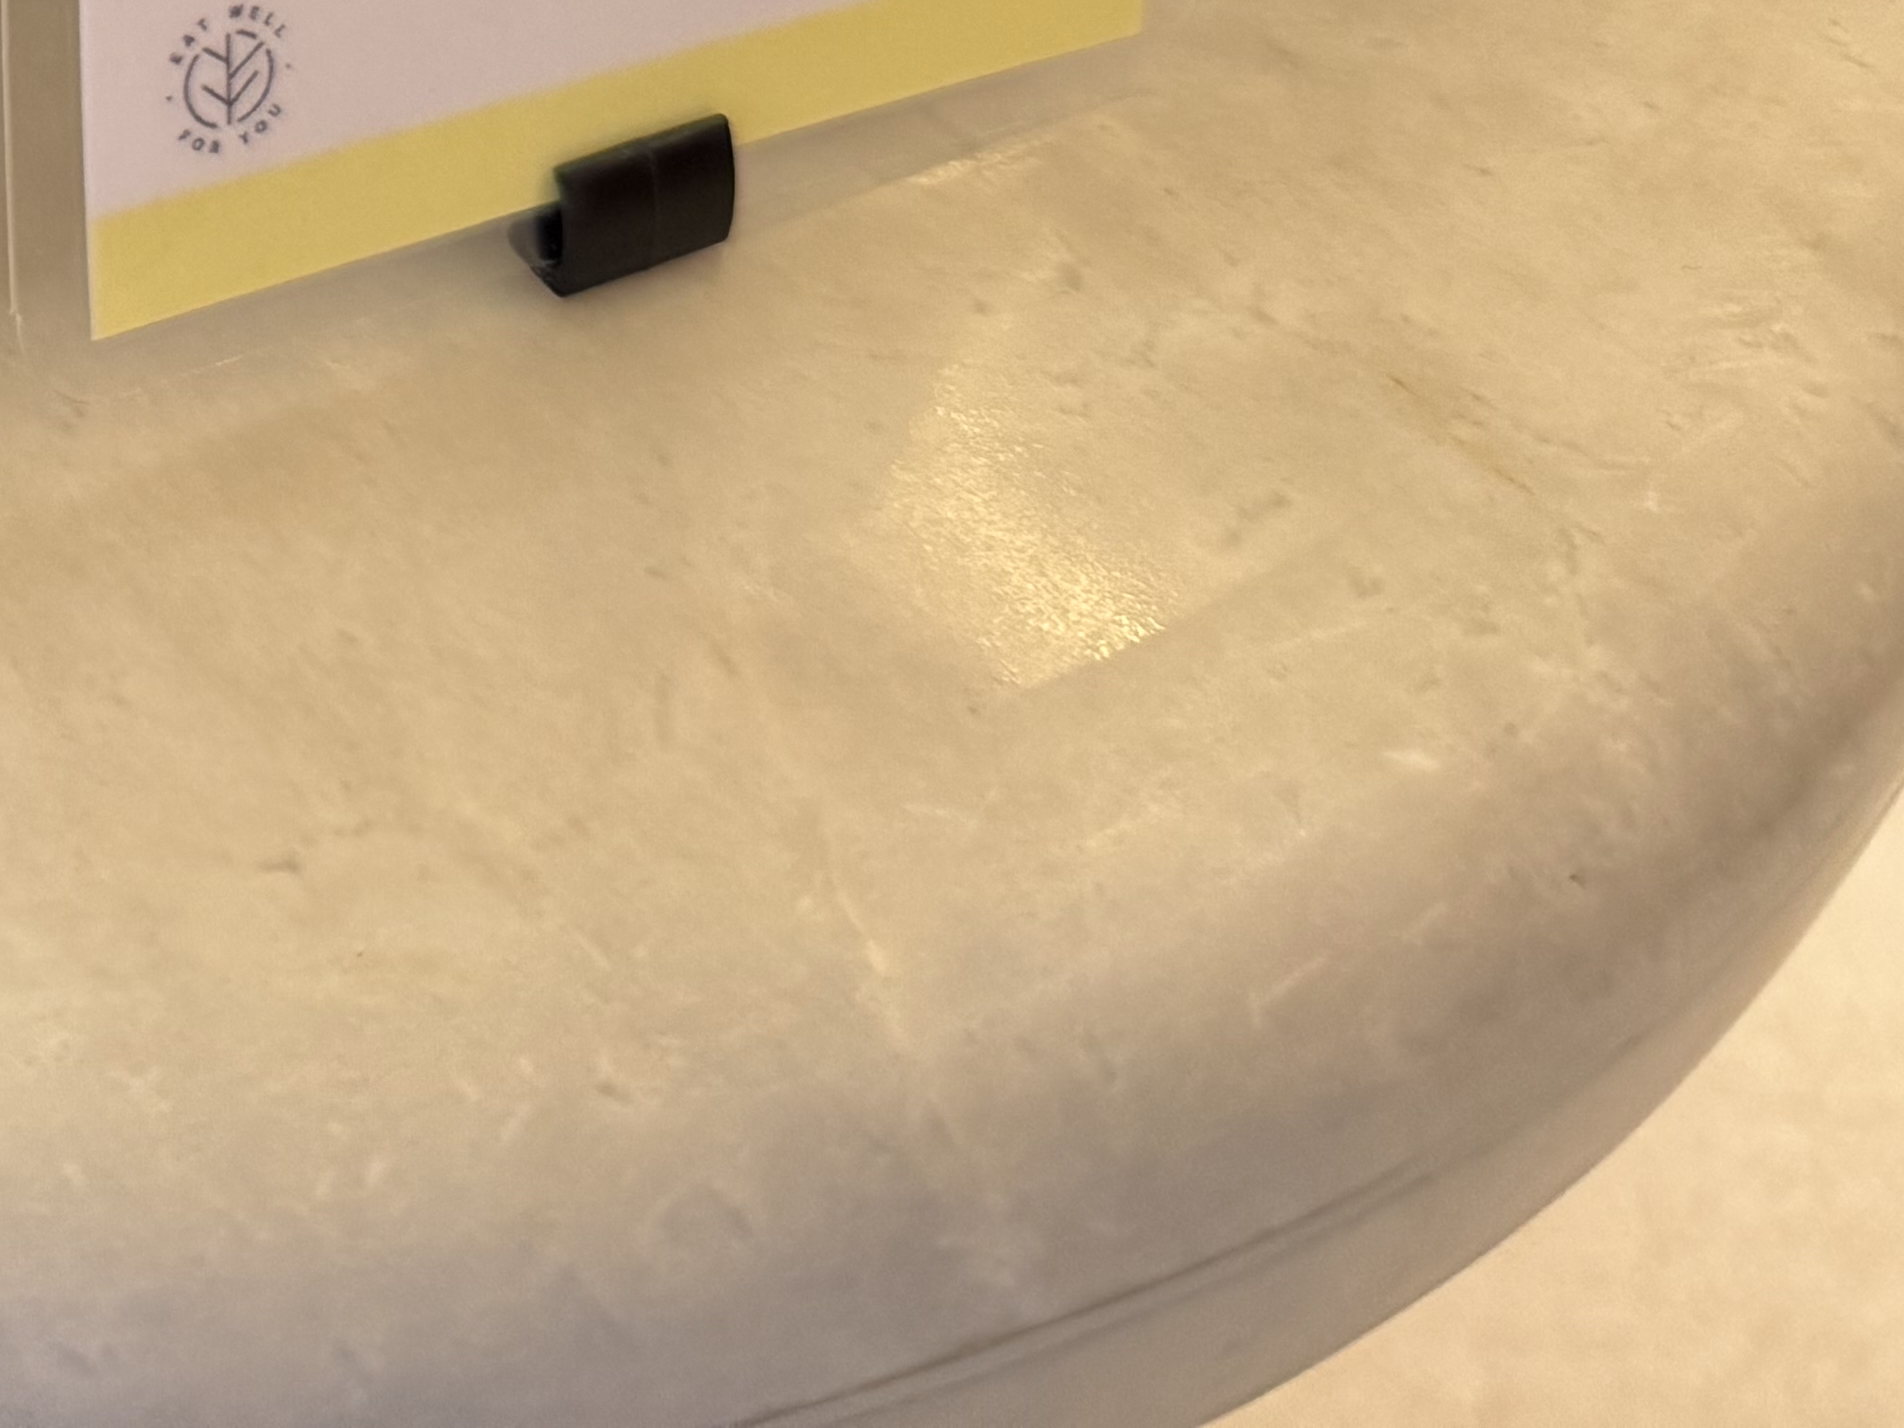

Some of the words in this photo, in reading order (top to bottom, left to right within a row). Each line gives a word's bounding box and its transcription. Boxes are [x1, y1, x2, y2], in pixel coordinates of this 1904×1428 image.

[168, 17, 209, 66] EAT
[228, 3, 287, 40] WELL
[176, 128, 221, 155] FOR
[237, 102, 283, 145] YOU
